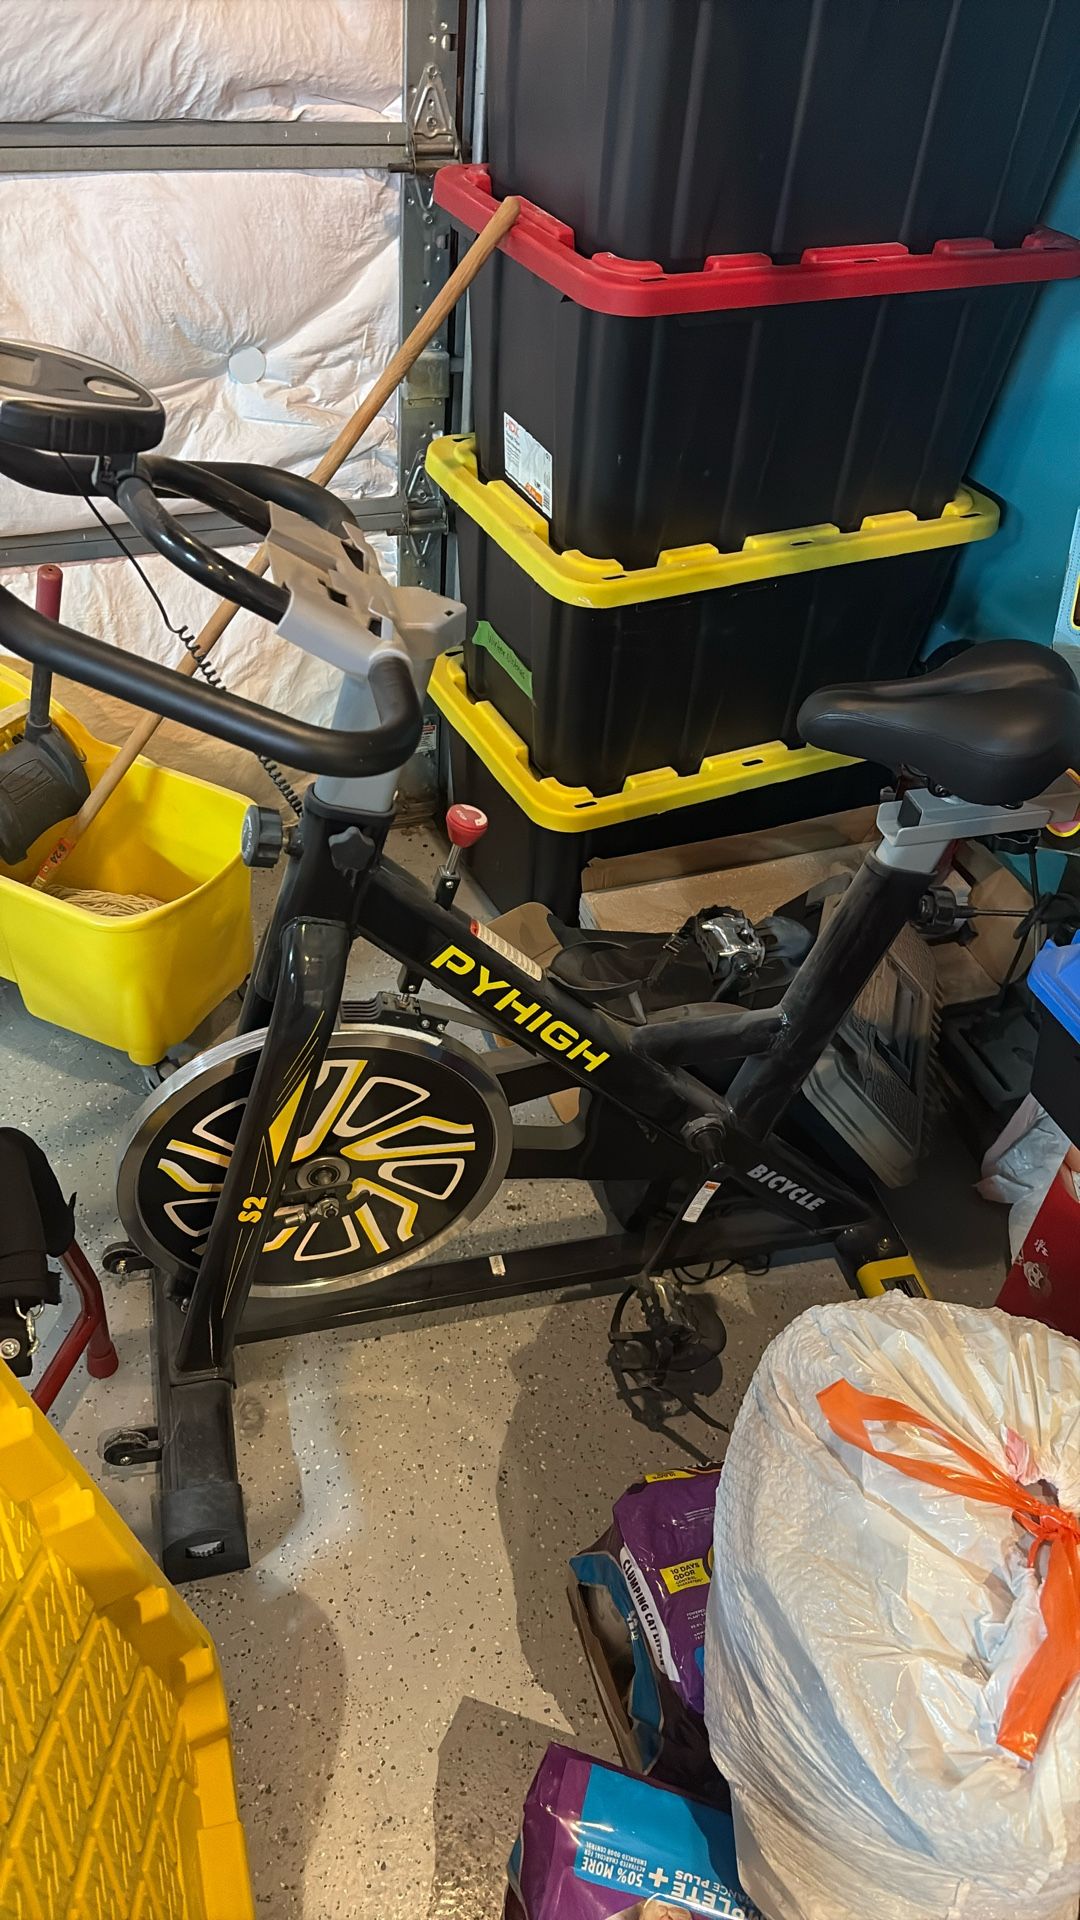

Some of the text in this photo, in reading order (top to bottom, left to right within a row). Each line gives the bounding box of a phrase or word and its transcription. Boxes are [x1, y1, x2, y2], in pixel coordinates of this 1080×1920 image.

[430, 945, 610, 1072] PYHIGH
[746, 1163, 826, 1211] BICYCLE
[238, 1197, 267, 1223] S2
[673, 1569, 696, 1581] ODOR
[680, 1562, 700, 1573] DAYS
[622, 1559, 649, 1613] CLUMPING
[645, 1612, 657, 1631] CAT
[581, 1856, 645, 1888] 50% MORE
[675, 1869, 710, 1889] PLUS
